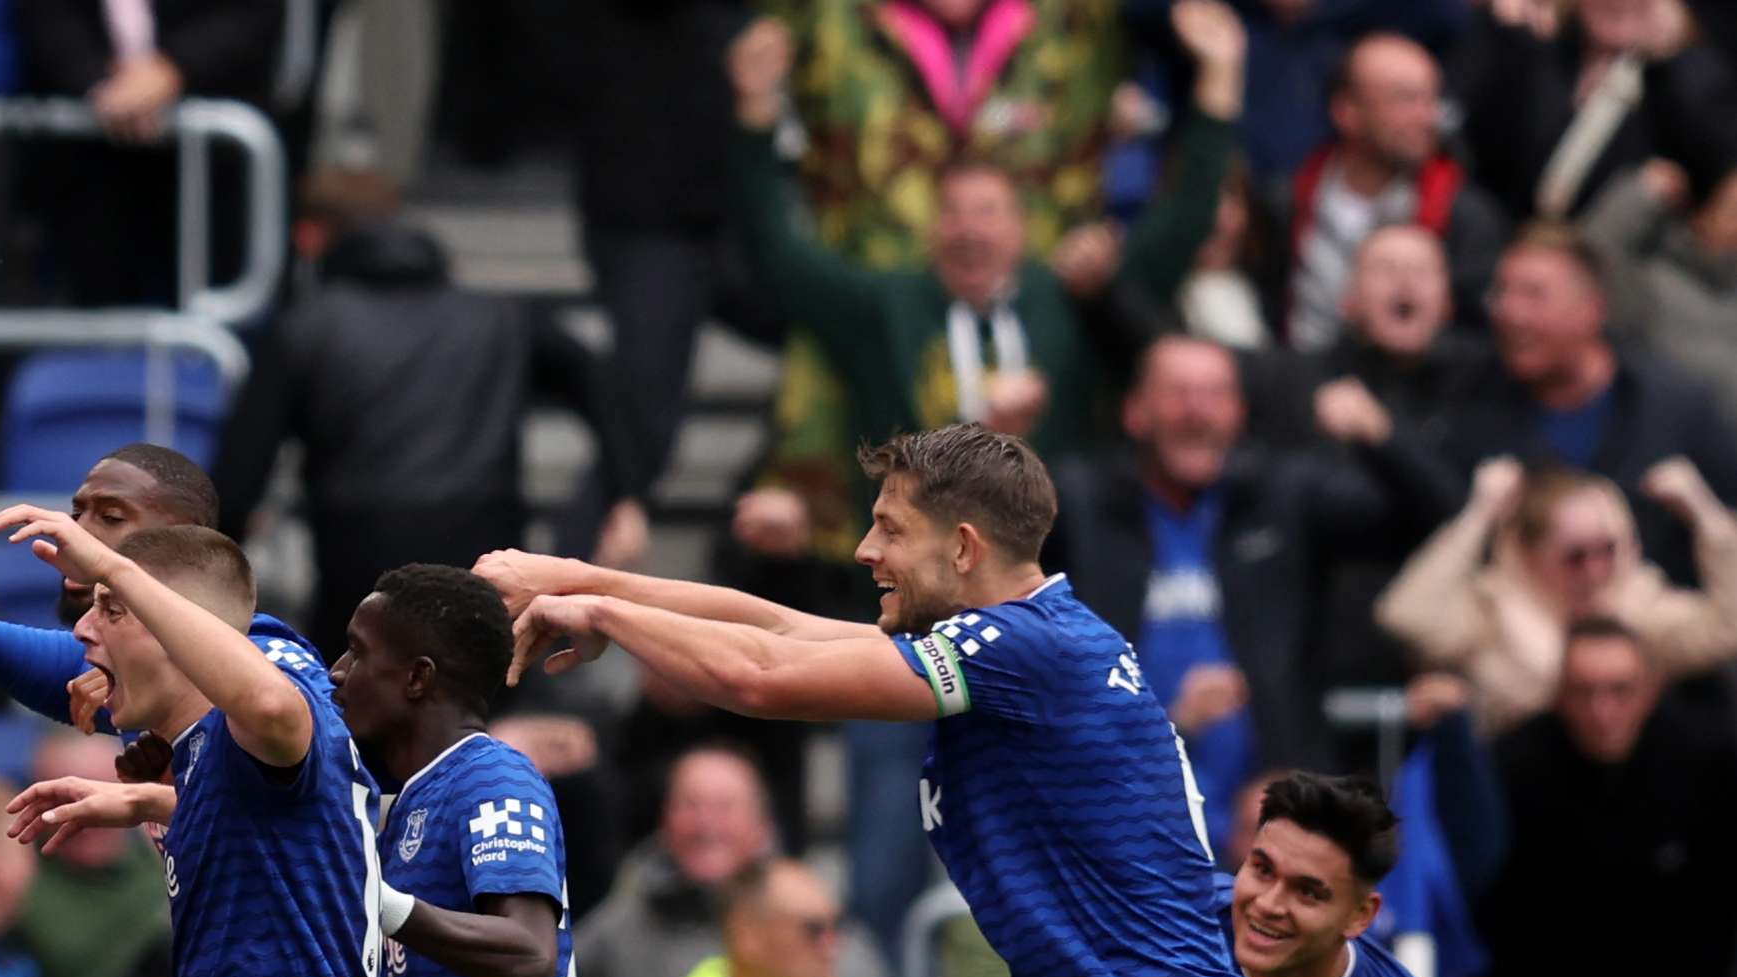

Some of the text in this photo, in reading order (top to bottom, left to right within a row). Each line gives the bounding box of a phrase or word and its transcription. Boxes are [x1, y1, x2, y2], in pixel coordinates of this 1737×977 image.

[920, 635, 956, 694] aptain
[471, 837, 547, 854] Christopher
[471, 849, 507, 867] Ward
